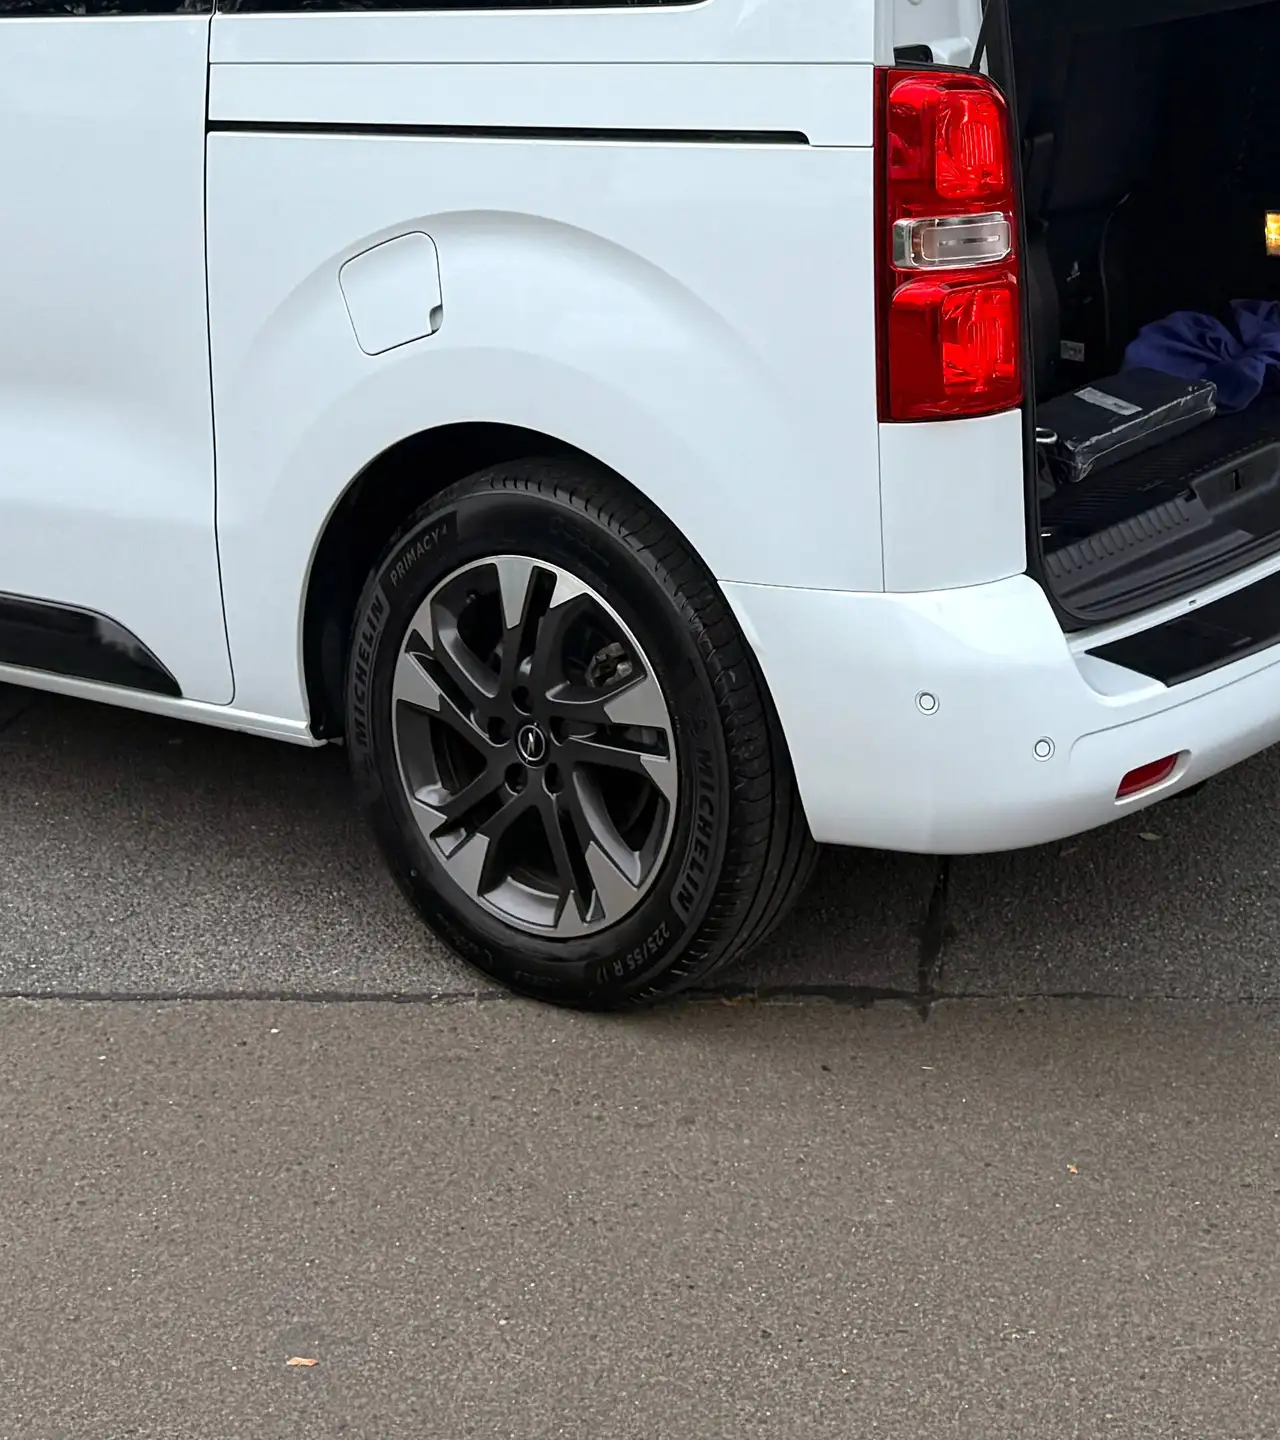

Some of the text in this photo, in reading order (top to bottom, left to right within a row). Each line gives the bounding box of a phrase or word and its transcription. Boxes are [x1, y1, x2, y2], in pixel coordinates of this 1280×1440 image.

[389, 530, 440, 587] PRIMACY
[355, 594, 386, 748] MICHELIN
[677, 747, 716, 913] MICHELIN
[614, 960, 624, 978] R
[626, 919, 671, 971] 225/55
